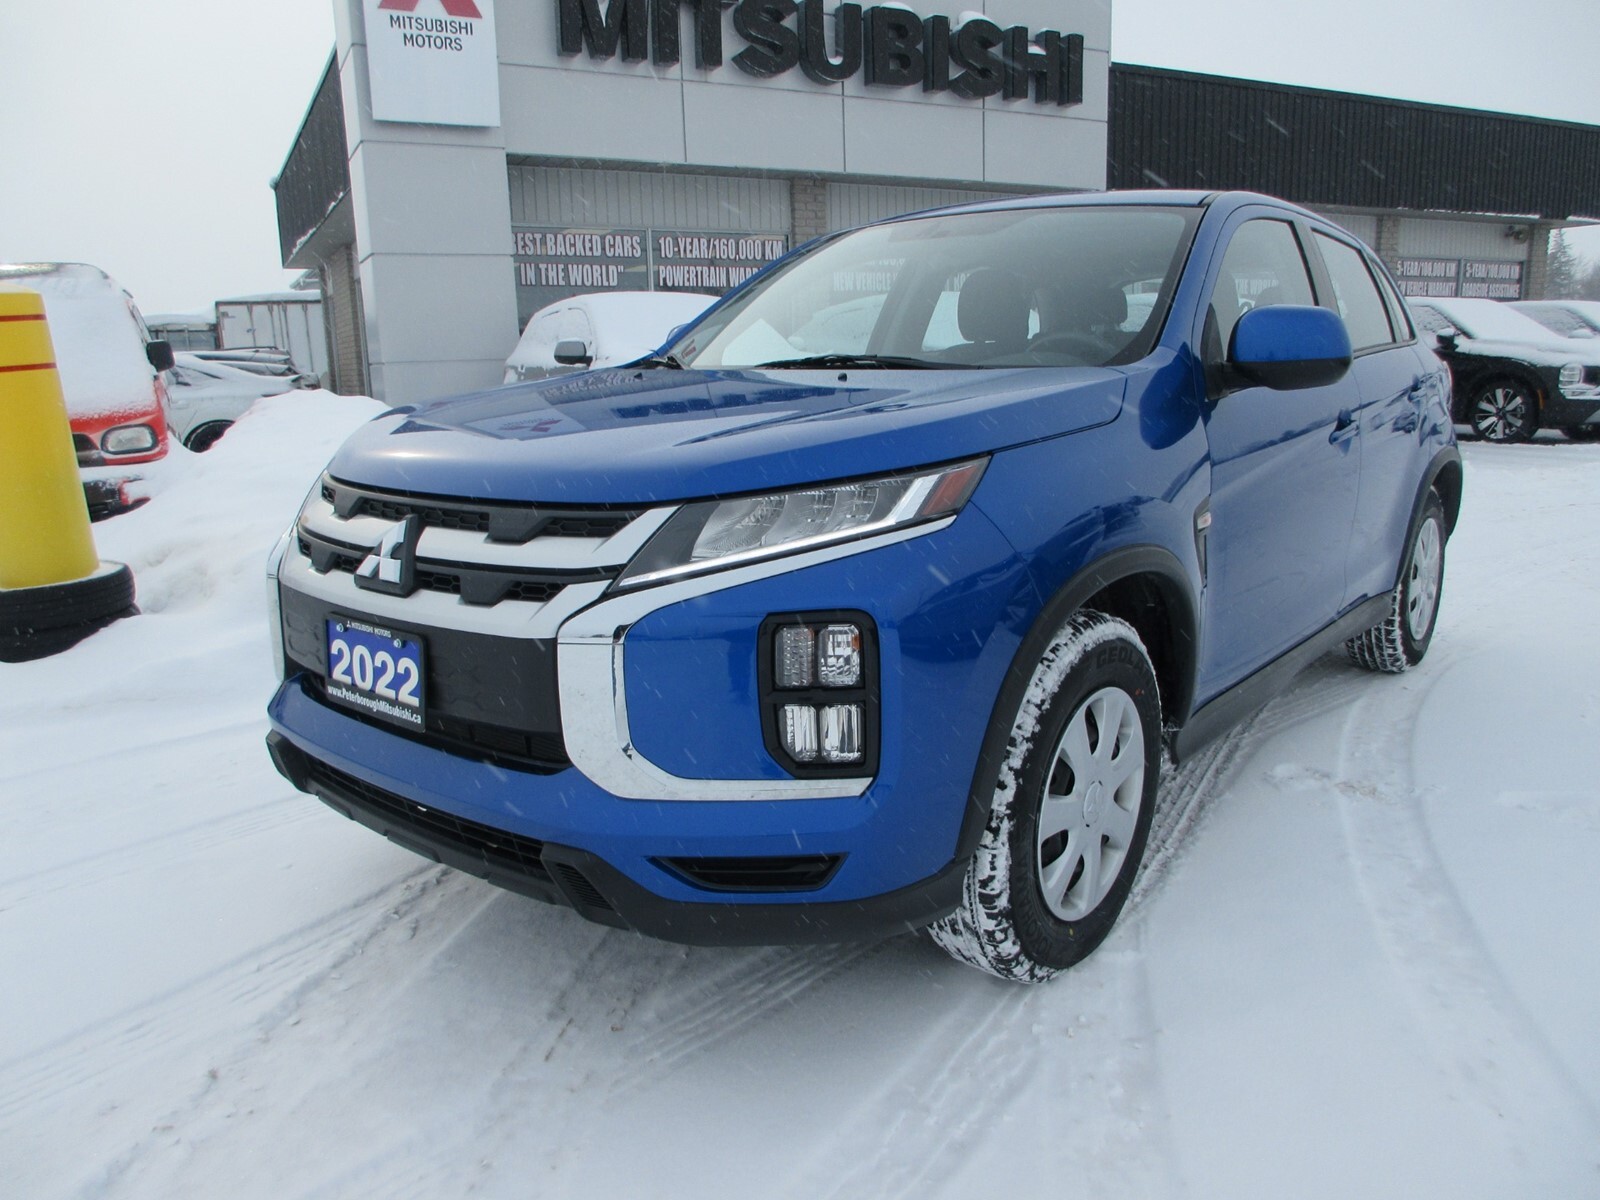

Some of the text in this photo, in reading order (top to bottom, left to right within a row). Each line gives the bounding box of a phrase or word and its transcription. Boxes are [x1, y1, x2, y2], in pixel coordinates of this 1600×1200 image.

[389, 14, 474, 36] MITSUBISHI
[403, 32, 463, 52] MOTORS
[556, 0, 1084, 106] MITSUBISHI
[545, 233, 603, 257] BACKED
[604, 234, 642, 258] CARS
[659, 236, 783, 261] 10-YEAR/160,000 KM
[520, 263, 624, 287] IN THE WORLD"
[659, 265, 727, 287] POWERTRAIN
[374, 627, 392, 638] MOTORS
[330, 639, 420, 707] 2022
[327, 685, 422, 724] www.PeterboroughMitsubishi.ca
